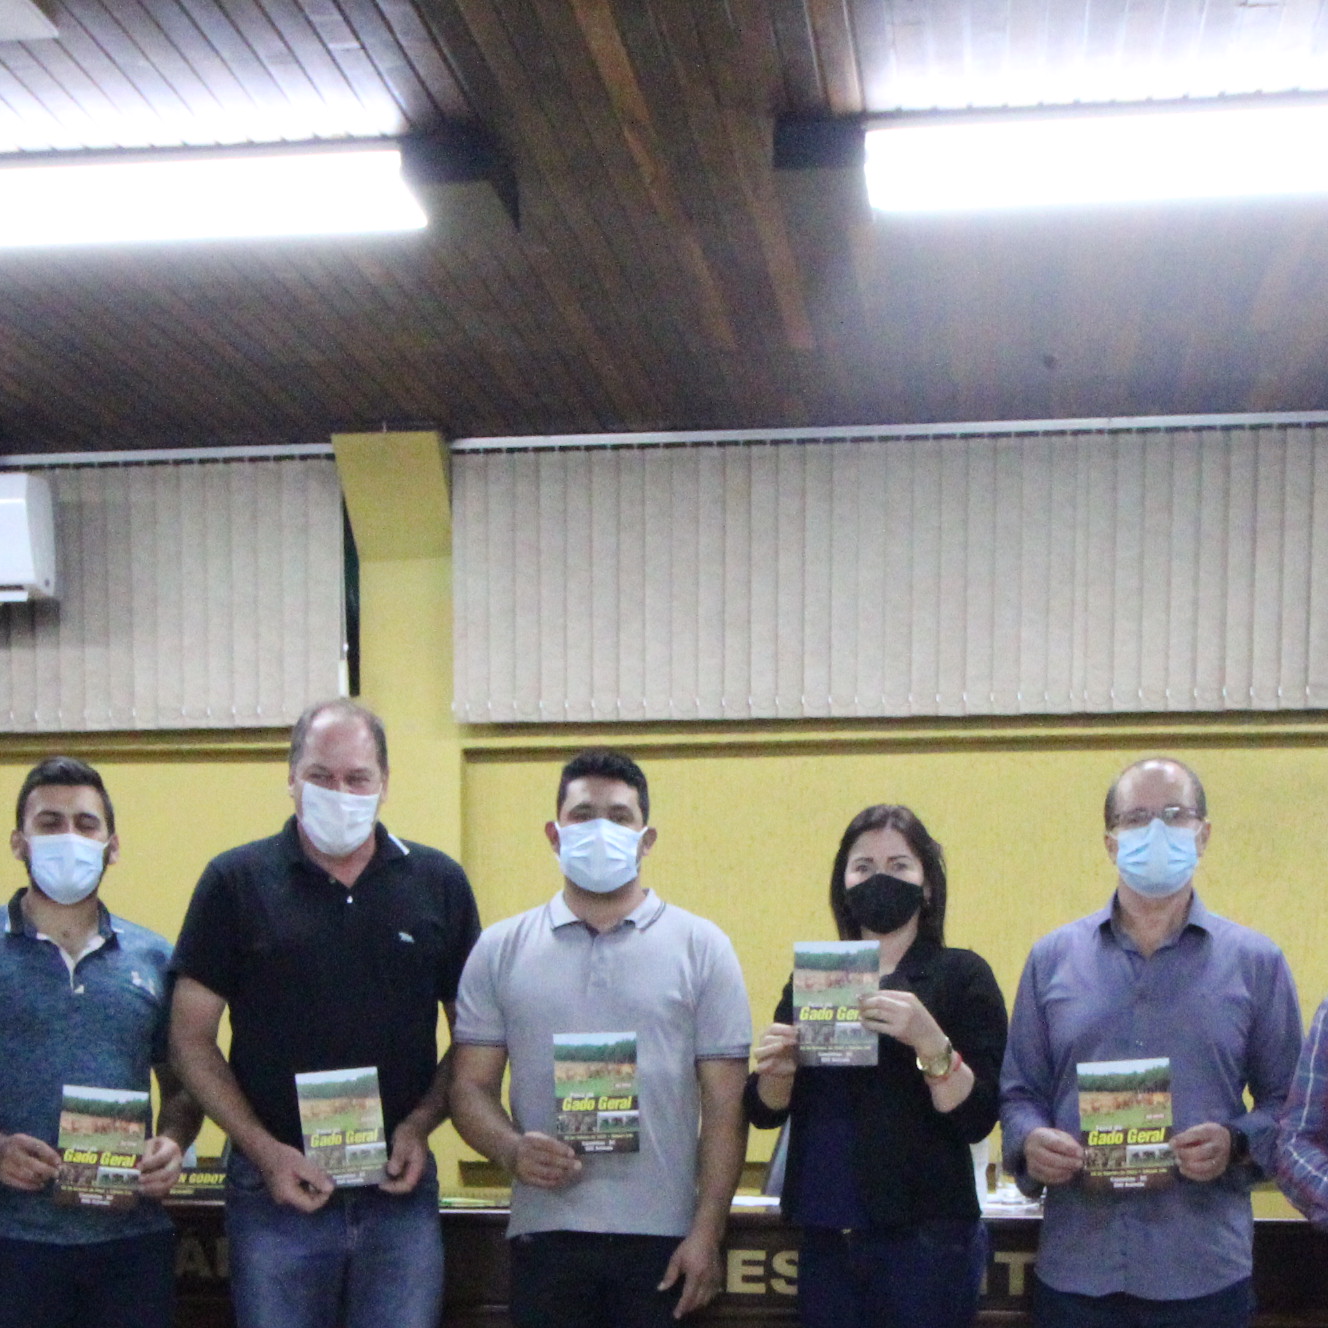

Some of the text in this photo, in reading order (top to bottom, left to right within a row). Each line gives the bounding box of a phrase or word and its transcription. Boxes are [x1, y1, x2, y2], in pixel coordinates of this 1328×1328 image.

[800, 1006, 860, 1020] Gado Ger
[562, 1096, 632, 1111] Gado Geral
[310, 1128, 378, 1148] Gado Geral
[1088, 1127, 1166, 1145] Gado Geral
[63, 1148, 136, 1168] Gado Geral
